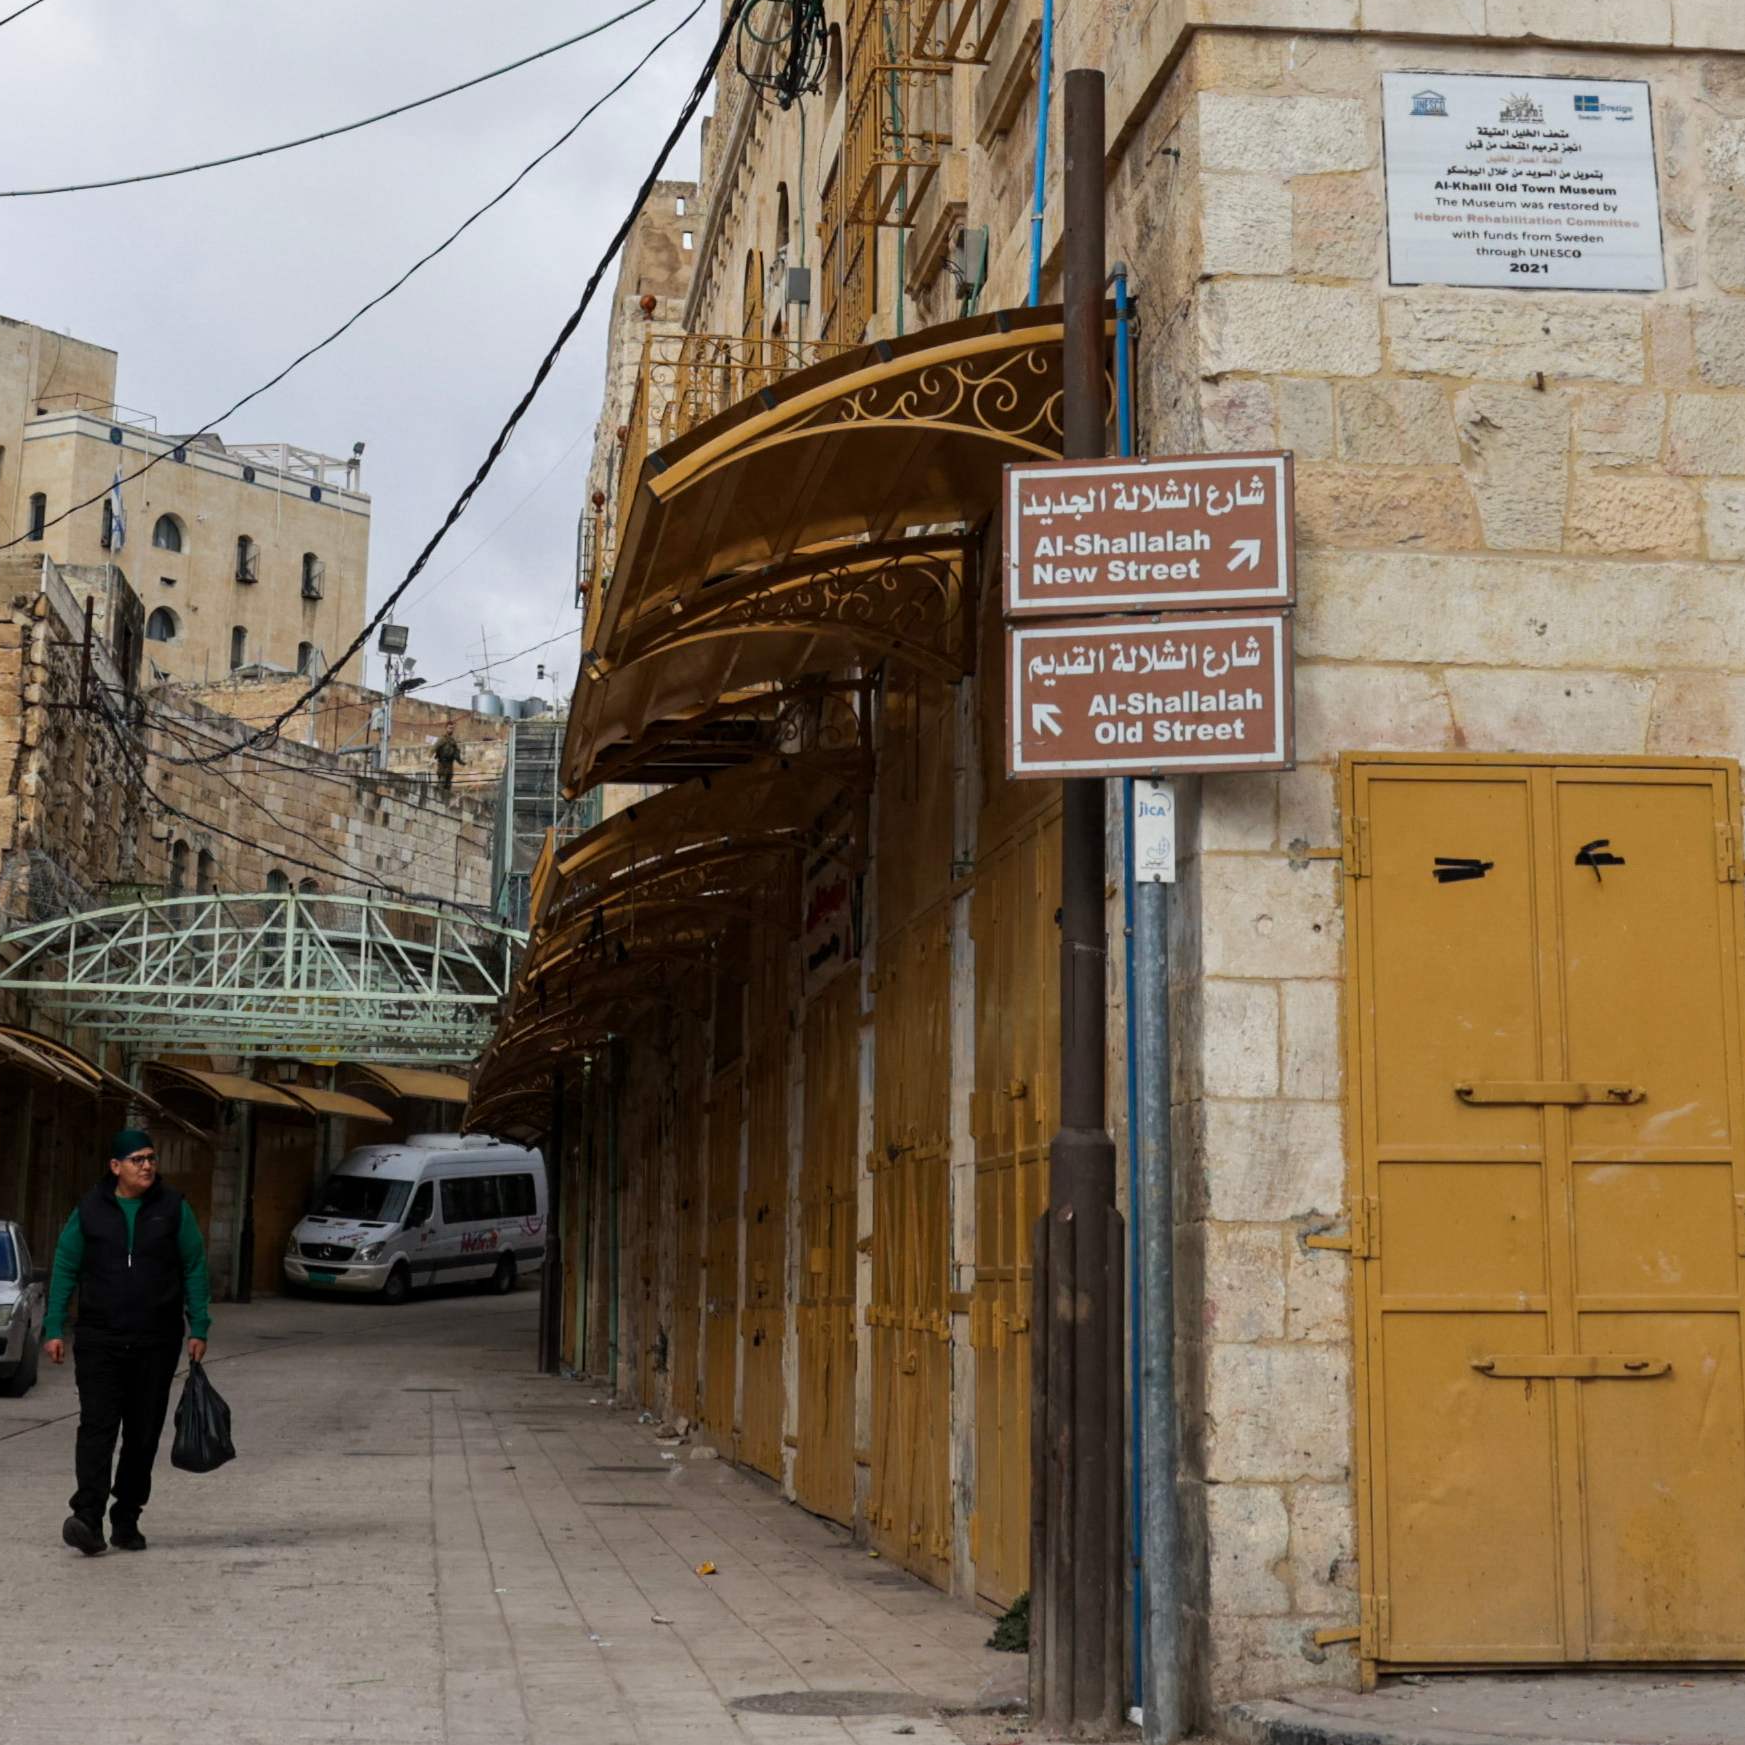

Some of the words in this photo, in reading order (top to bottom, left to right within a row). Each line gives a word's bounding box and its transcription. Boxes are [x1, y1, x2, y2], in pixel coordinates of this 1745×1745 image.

[1476, 127, 1509, 138] العتيقة
[1512, 129, 1540, 139] الخليل
[1542, 129, 1569, 139] متحف
[1465, 139, 1483, 150] قبل
[1486, 142, 1497, 151] من
[1532, 142, 1559, 153] ترميم
[1446, 165, 1486, 177] اليونسكو
[1487, 167, 1509, 177] خلال
[1511, 168, 1523, 178] من
[1525, 169, 1557, 180] السويد
[1559, 170, 1571, 180] من
[1573, 170, 1604, 181] بتمويل
[1434, 181, 1492, 192] Al-Khalil
[1495, 183, 1518, 193] Old
[1521, 184, 1555, 194] Town
[1559, 185, 1617, 195] Museum
[1435, 197, 1458, 207] The
[1462, 198, 1517, 208] Museum
[1521, 201, 1544, 209] was
[1548, 202, 1600, 211] restored
[1603, 203, 1618, 213] by
[1414, 212, 1463, 223] Hebron
[1467, 214, 1562, 225] Rehabilitation
[1566, 217, 1640, 228] Committee
[1452, 230, 1480, 240] with
[1484, 231, 1518, 241] funds
[1522, 232, 1552, 241] from
[1555, 233, 1604, 243] Sweden
[1476, 246, 1526, 258] through
[1529, 248, 1582, 258] UNESCO
[1509, 263, 1549, 274] 2021
[1111, 478, 1201, 513] الشلالة
[1206, 474, 1265, 517] شارع
[1022, 485, 1107, 526] الجديد
[1034, 529, 1211, 558] Al-Shallalah
[1032, 563, 1098, 585] New
[1107, 558, 1200, 582] Street
[1109, 639, 1198, 674] الشلالة
[1202, 634, 1261, 678] شارع
[1028, 645, 1105, 687] القديم
[1087, 688, 1263, 717] Al-Shallalah
[1094, 721, 1143, 744] Old
[1153, 718, 1245, 743] Street
